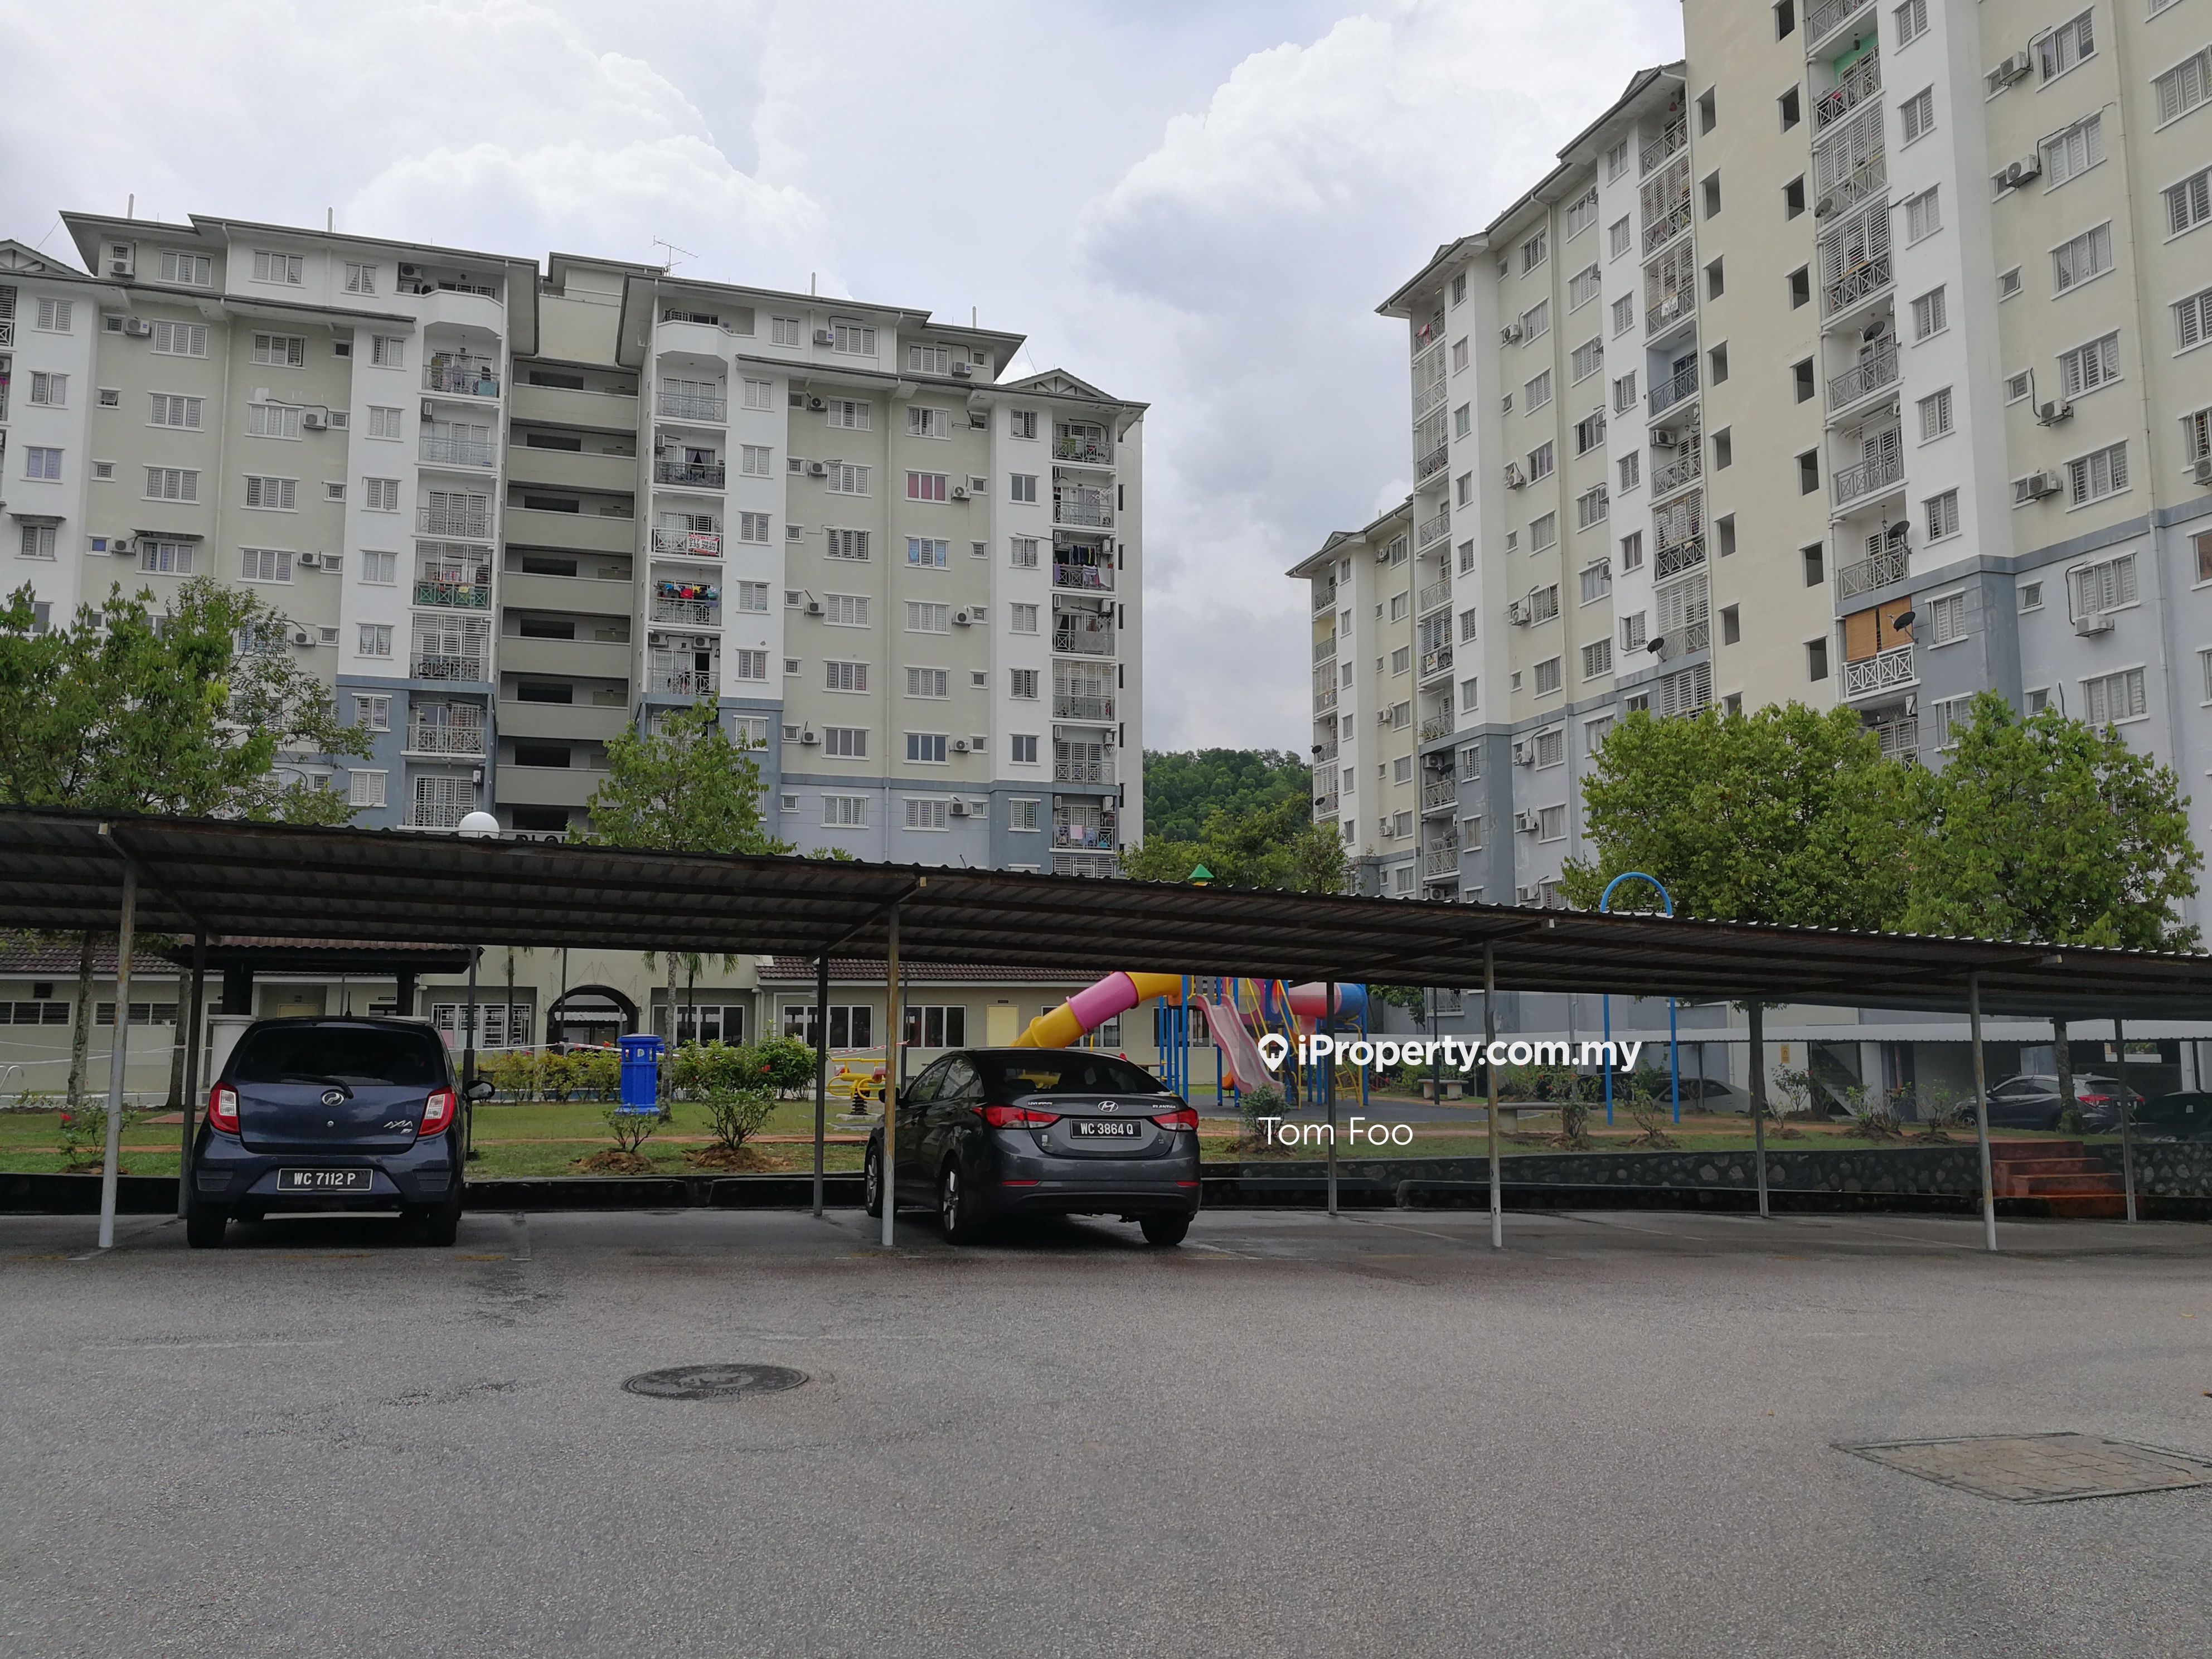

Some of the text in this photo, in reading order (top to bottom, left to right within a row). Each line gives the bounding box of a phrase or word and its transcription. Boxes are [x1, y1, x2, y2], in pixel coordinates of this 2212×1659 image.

[383, 1119, 413, 1129] AXIA
[1080, 1123, 1134, 1135] WC 3864 Q
[294, 1172, 356, 1185] WC 7112 P
